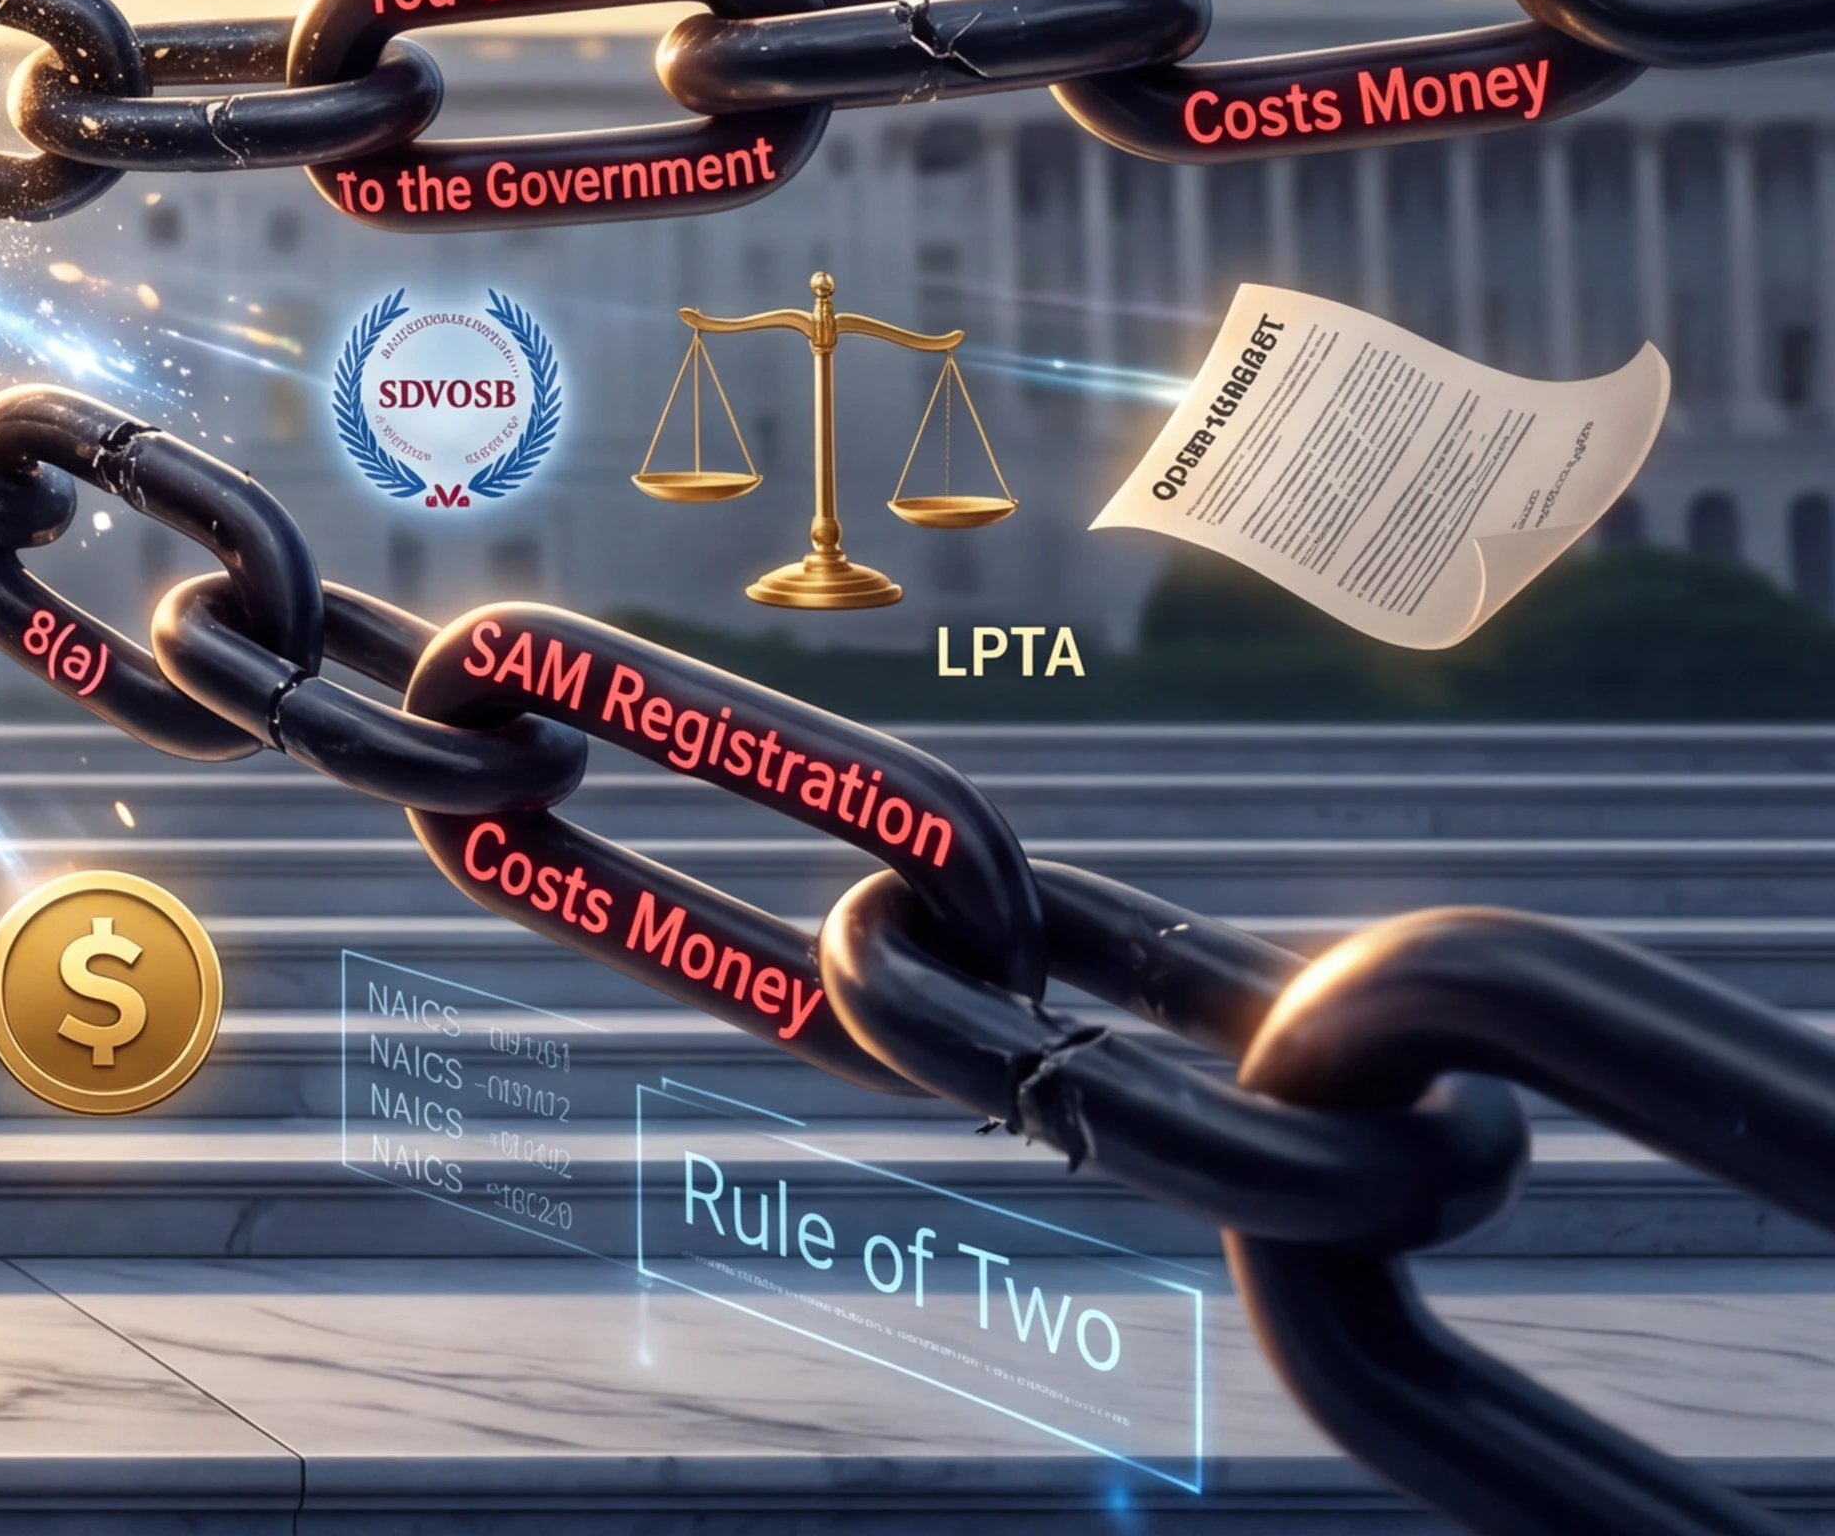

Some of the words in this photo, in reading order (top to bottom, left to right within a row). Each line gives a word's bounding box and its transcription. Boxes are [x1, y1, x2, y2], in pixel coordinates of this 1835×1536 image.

[1185, 84, 1341, 143] Costs
[1358, 60, 1548, 124] Money
[398, 166, 471, 212] the
[487, 138, 775, 207] Government
[379, 380, 516, 408] SDVOSB
[24, 610, 108, 695] 8(a)
[937, 625, 1085, 677] LPTA
[464, 617, 591, 709] SAM
[602, 664, 952, 866] Registration
[465, 822, 612, 933] Costs
[627, 891, 823, 1039] Money
[57, 917, 147, 1067] $
[369, 981, 461, 1037] NAICS
[371, 1034, 462, 1089] NAICS
[372, 1083, 463, 1139] NAICS
[373, 1133, 463, 1193] NAICS
[683, 1150, 836, 1271] Rule
[863, 1228, 937, 1308] of
[958, 1241, 1121, 1373] Two
